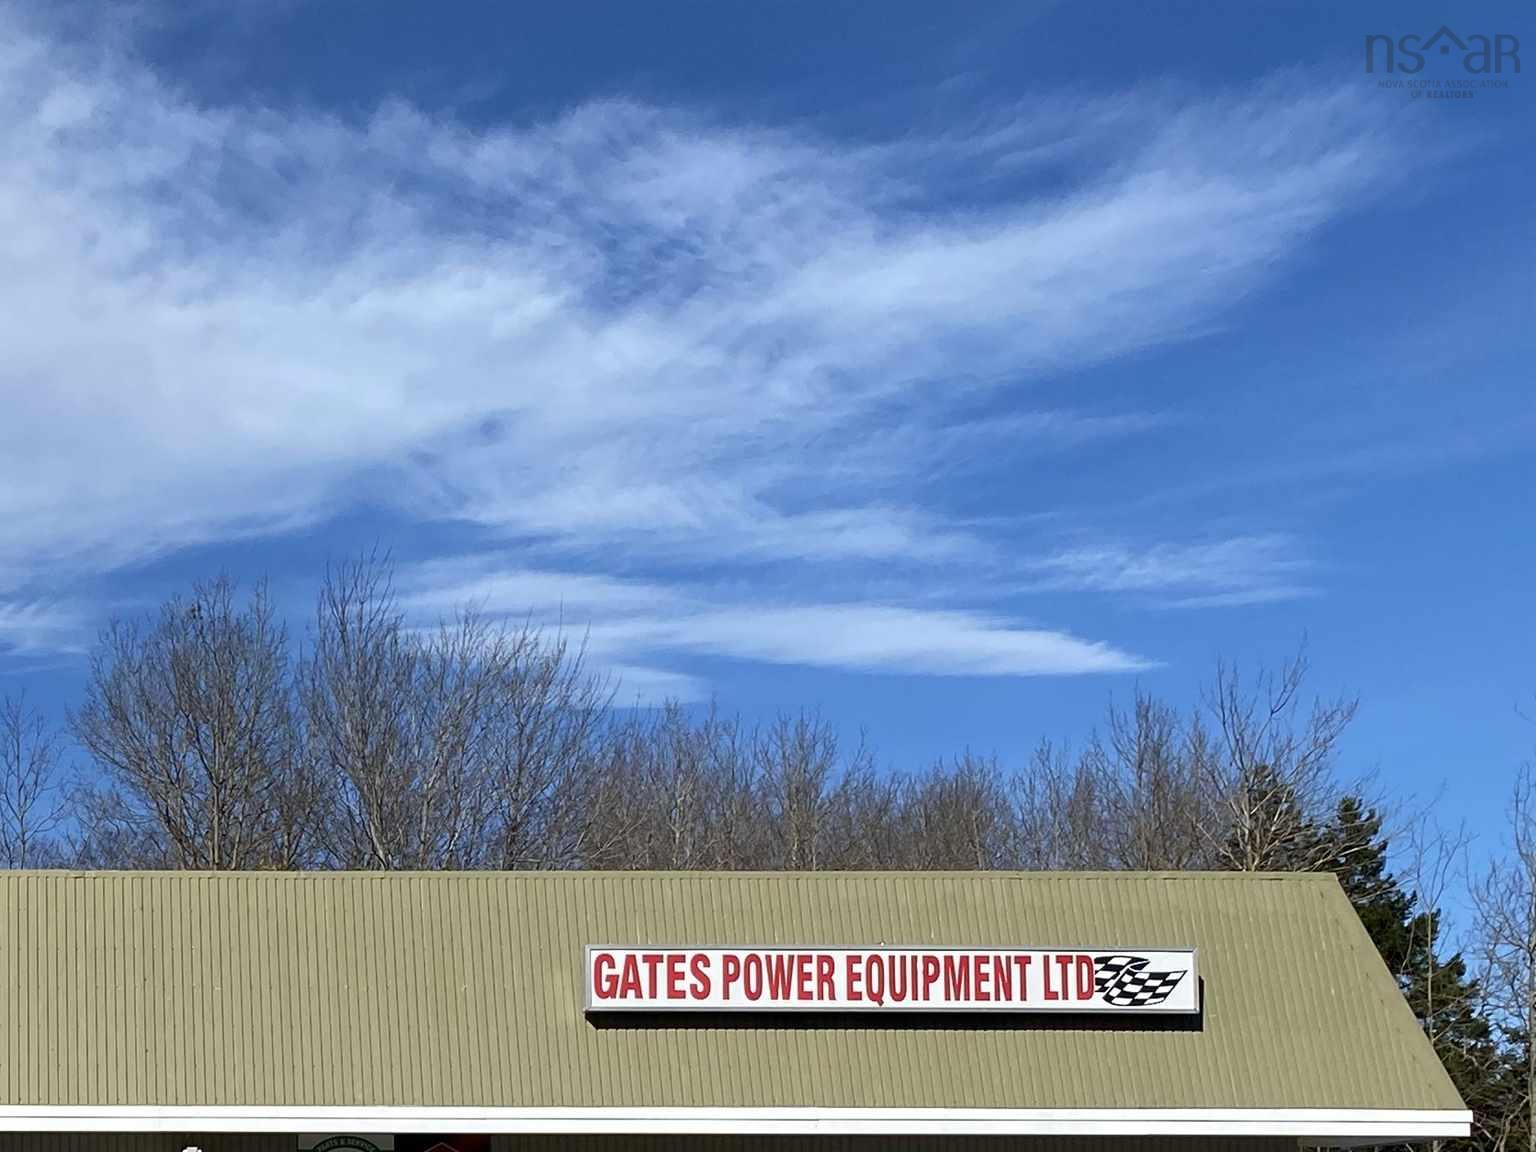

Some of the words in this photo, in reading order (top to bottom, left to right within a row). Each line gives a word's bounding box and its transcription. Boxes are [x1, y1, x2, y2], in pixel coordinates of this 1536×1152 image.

[593, 953, 712, 1000] GATES
[722, 953, 837, 1001] POWER
[846, 953, 1032, 1007] EQUIPMENT
[1043, 954, 1095, 1001] LTD
